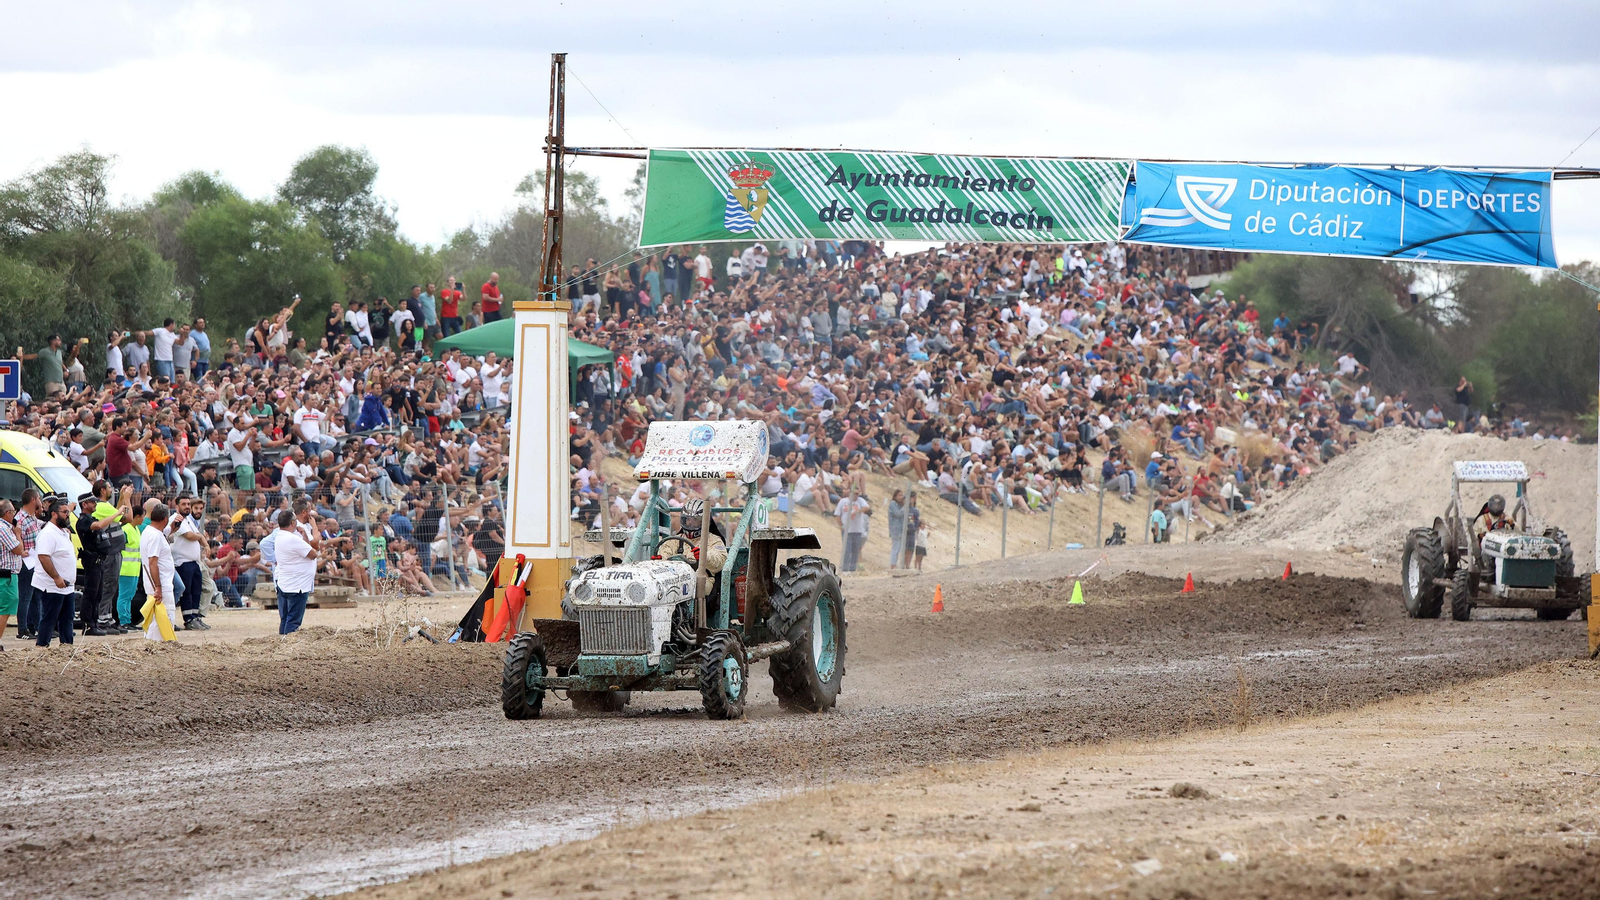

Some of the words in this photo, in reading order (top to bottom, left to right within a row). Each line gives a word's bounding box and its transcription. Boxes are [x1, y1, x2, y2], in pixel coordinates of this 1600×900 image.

[824, 164, 1036, 193] Ayuntamiento
[1249, 179, 1391, 207] Diputación
[1418, 189, 1541, 212] DEPORTES
[818, 200, 854, 223] de
[865, 200, 1053, 231] Guadalcacín
[1245, 210, 1276, 234] de
[1289, 212, 1364, 240] Cádiz
[658, 448, 741, 456] RECAMBIOS
[681, 471, 721, 479] VILLENA
[584, 571, 600, 580] EL
[606, 571, 633, 580] TIRA
